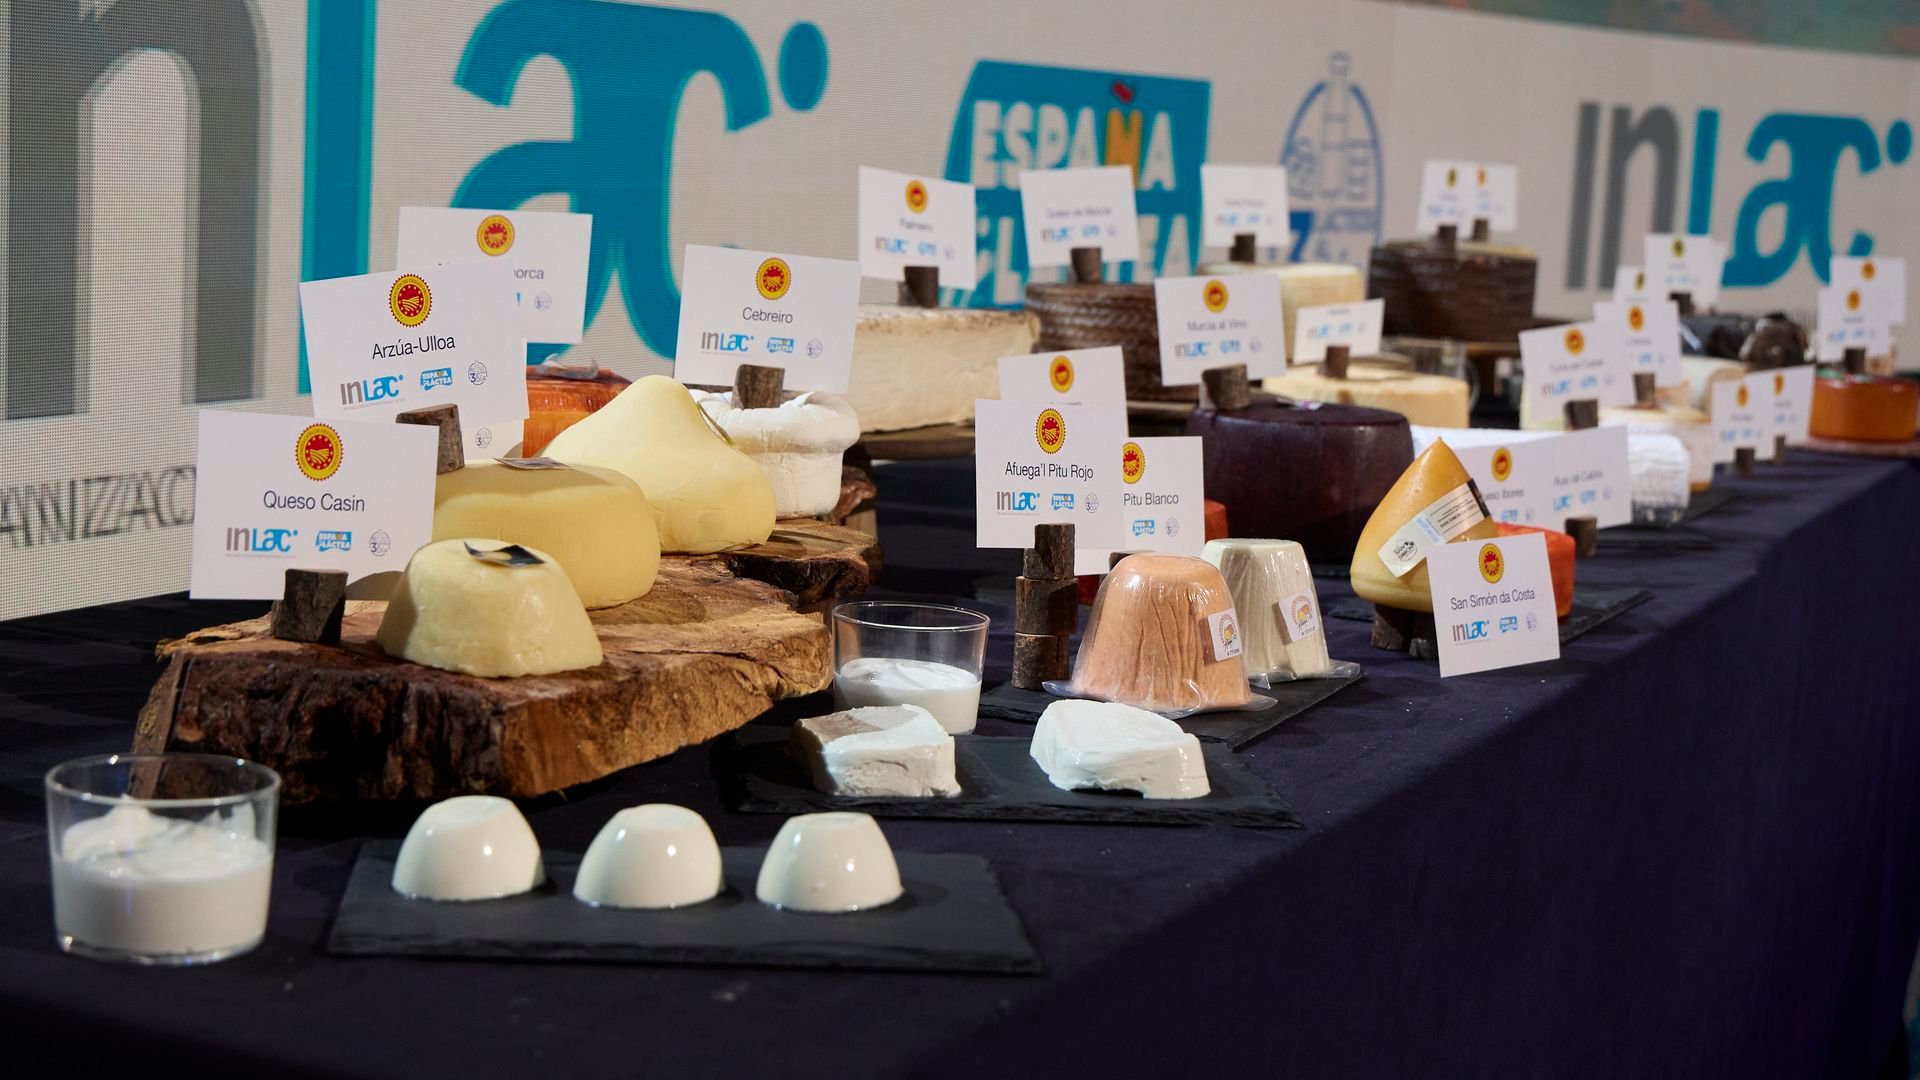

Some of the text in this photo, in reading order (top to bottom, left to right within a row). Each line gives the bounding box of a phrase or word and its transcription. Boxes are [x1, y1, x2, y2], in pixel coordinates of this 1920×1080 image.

[970, 81, 1176, 191] ESPAÑA
[742, 306, 794, 324] Cebreiro
[372, 335, 456, 359] Arzúa-Ulloa
[1005, 461, 1094, 481] Afuega'l Pitu Rojo
[263, 490, 365, 512] Queso Casin
[1123, 492, 1179, 506] Pitu Blanco
[1450, 588, 1536, 611] San Simón da Costa
